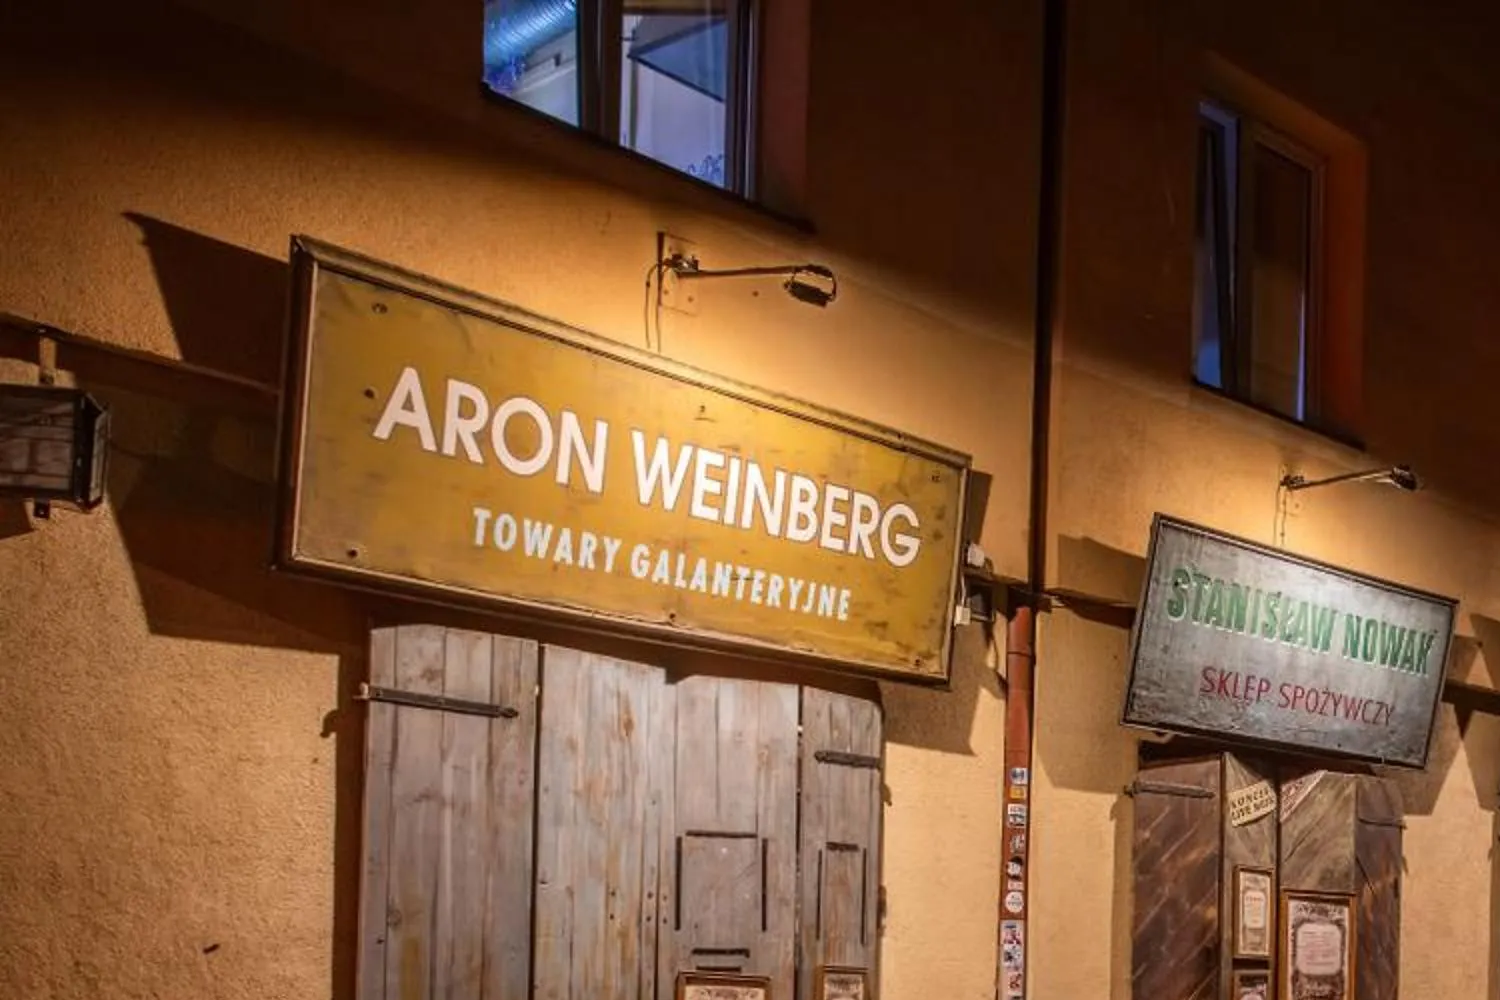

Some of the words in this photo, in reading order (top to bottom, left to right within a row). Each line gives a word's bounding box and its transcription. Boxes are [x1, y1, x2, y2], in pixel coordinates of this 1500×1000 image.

[373, 366, 609, 494] ARON
[631, 430, 920, 567] WEINBERG
[472, 507, 623, 574] TOWARY
[630, 542, 852, 621] GALANTERYJNE
[1167, 568, 1338, 653] STANISŁAW
[1341, 612, 1438, 677] NOWAK
[1200, 666, 1271, 702] SKLEP
[1277, 682, 1395, 727] SPOŻYWCZY
